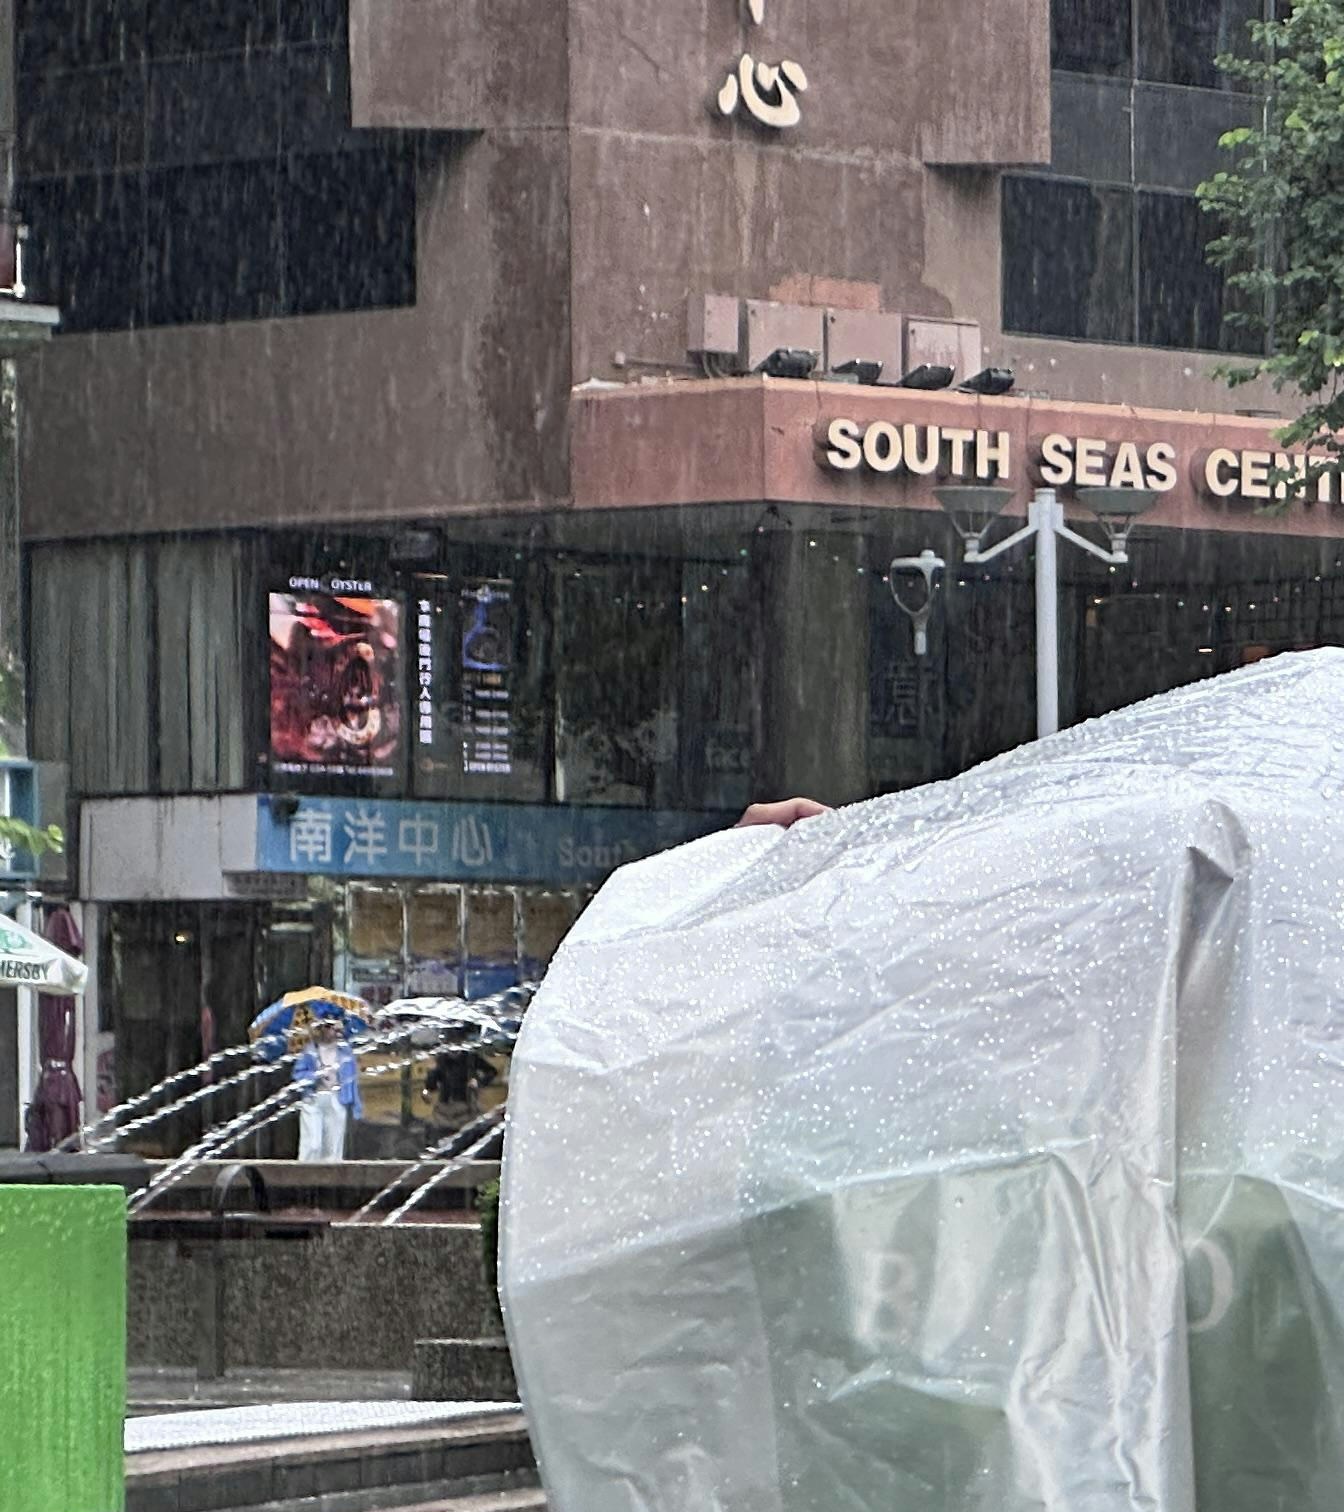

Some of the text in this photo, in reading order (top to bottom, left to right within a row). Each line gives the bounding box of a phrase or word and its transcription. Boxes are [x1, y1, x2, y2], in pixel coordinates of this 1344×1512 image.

[826, 418, 1009, 479] SOUTH
[1041, 433, 1177, 492] SEAS
[289, 575, 372, 592] OPEN OYSTER
[289, 808, 493, 867] 南洋中心
